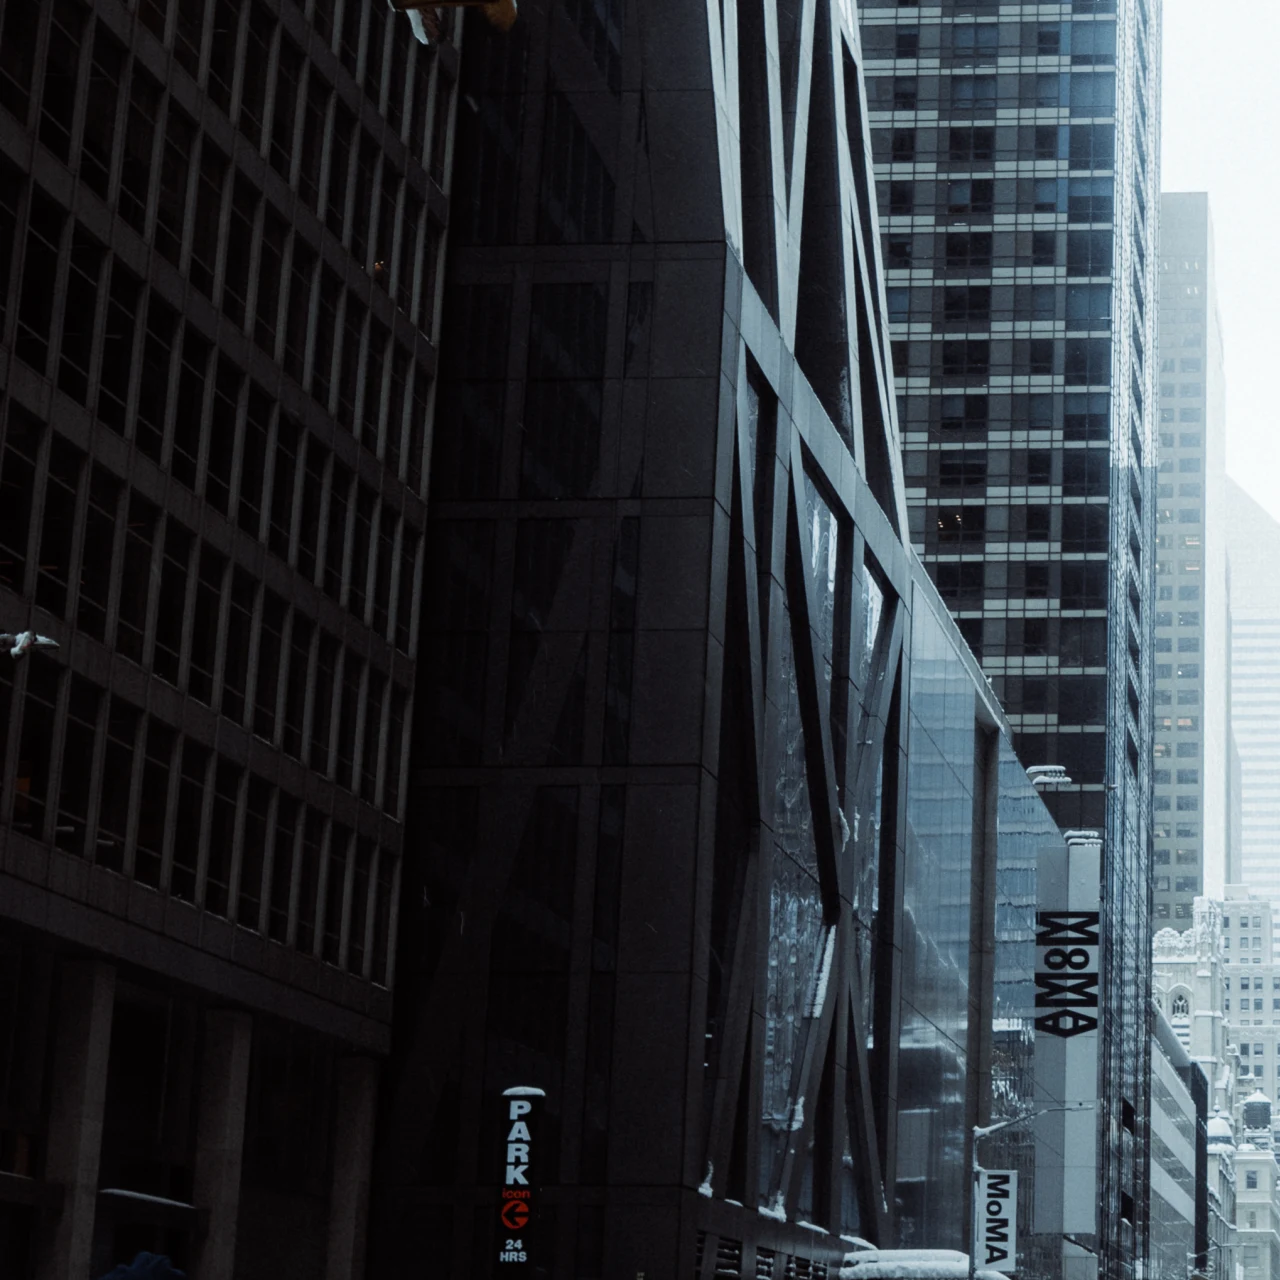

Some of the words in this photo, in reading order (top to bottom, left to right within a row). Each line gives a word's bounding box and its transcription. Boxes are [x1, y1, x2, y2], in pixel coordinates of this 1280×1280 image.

[505, 1100, 532, 1185] PARK
[501, 1187, 531, 1199] icon
[985, 1174, 1010, 1265] MoMA
[505, 1238, 523, 1251] 24
[499, 1251, 528, 1263] HRS
